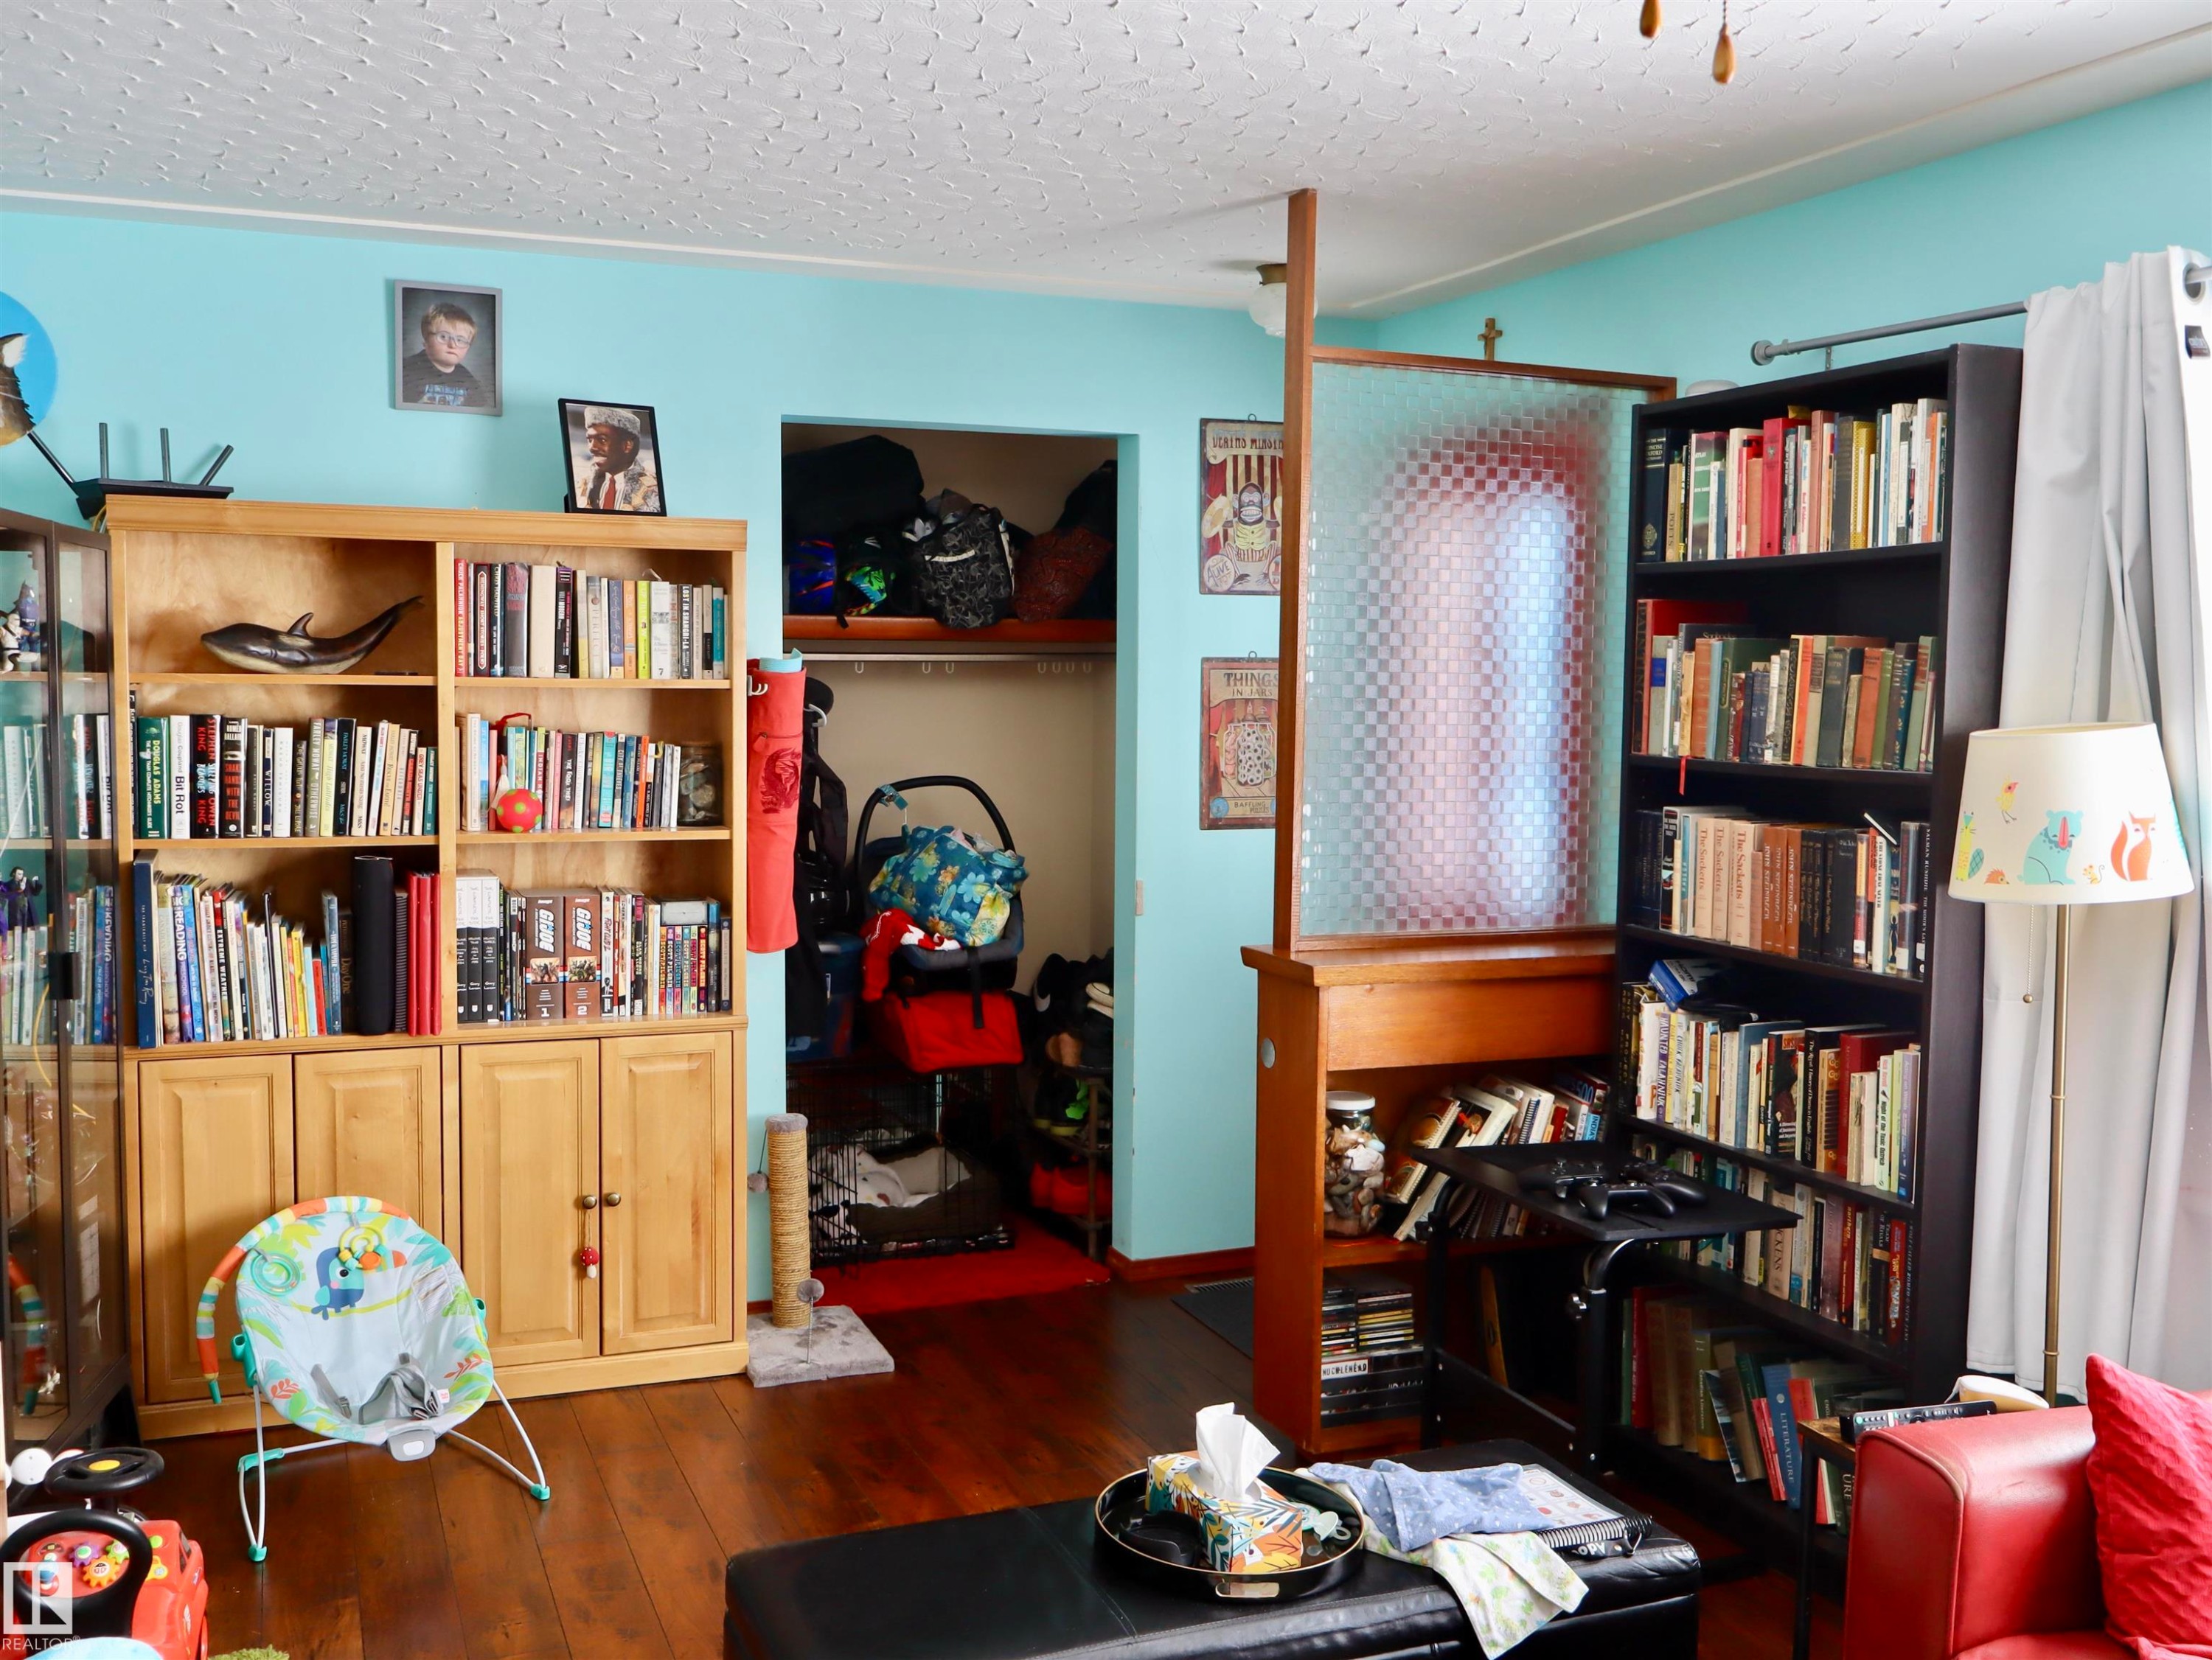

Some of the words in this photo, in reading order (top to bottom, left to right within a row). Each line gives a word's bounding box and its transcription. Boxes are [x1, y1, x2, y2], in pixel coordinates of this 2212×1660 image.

[1224, 672, 1279, 688] THINGS
[1250, 689, 1273, 697] JARS
[198, 728, 206, 751] KING
[208, 719, 216, 759] STEPHEN
[313, 722, 321, 745] FARLEY
[153, 740, 161, 775] DOUGLAS
[311, 748, 320, 771] MOWAT
[153, 778, 161, 803] ADAMS
[175, 776, 185, 791] Bit
[175, 795, 185, 814] Rot
[198, 800, 206, 823] KING
[309, 783, 318, 818] OTHERWISE
[1700, 828, 1708, 848] The
[1717, 827, 1725, 847] The
[1736, 831, 1747, 851] The
[1699, 848, 1707, 890] Sacketts
[1716, 850, 1725, 893] Sacketts
[1736, 854, 1747, 899] Sacketts
[175, 911, 187, 960] READING
[604, 918, 612, 932] FIGHT
[217, 930, 225, 963] EXTREME
[341, 958, 351, 974] Day
[180, 961, 188, 997] PRESCHOOL
[342, 975, 352, 994] One
[540, 1008, 550, 1017] 1
[577, 1006, 588, 1016] 2
[1659, 1016, 1669, 1054] HAUNTED
[1657, 1059, 1667, 1106] PALAHNIUK
[1903, 1081, 1908, 1089] on
[1780, 1412, 1795, 1483] LITERATURE
[1843, 1474, 1852, 1501] URE
